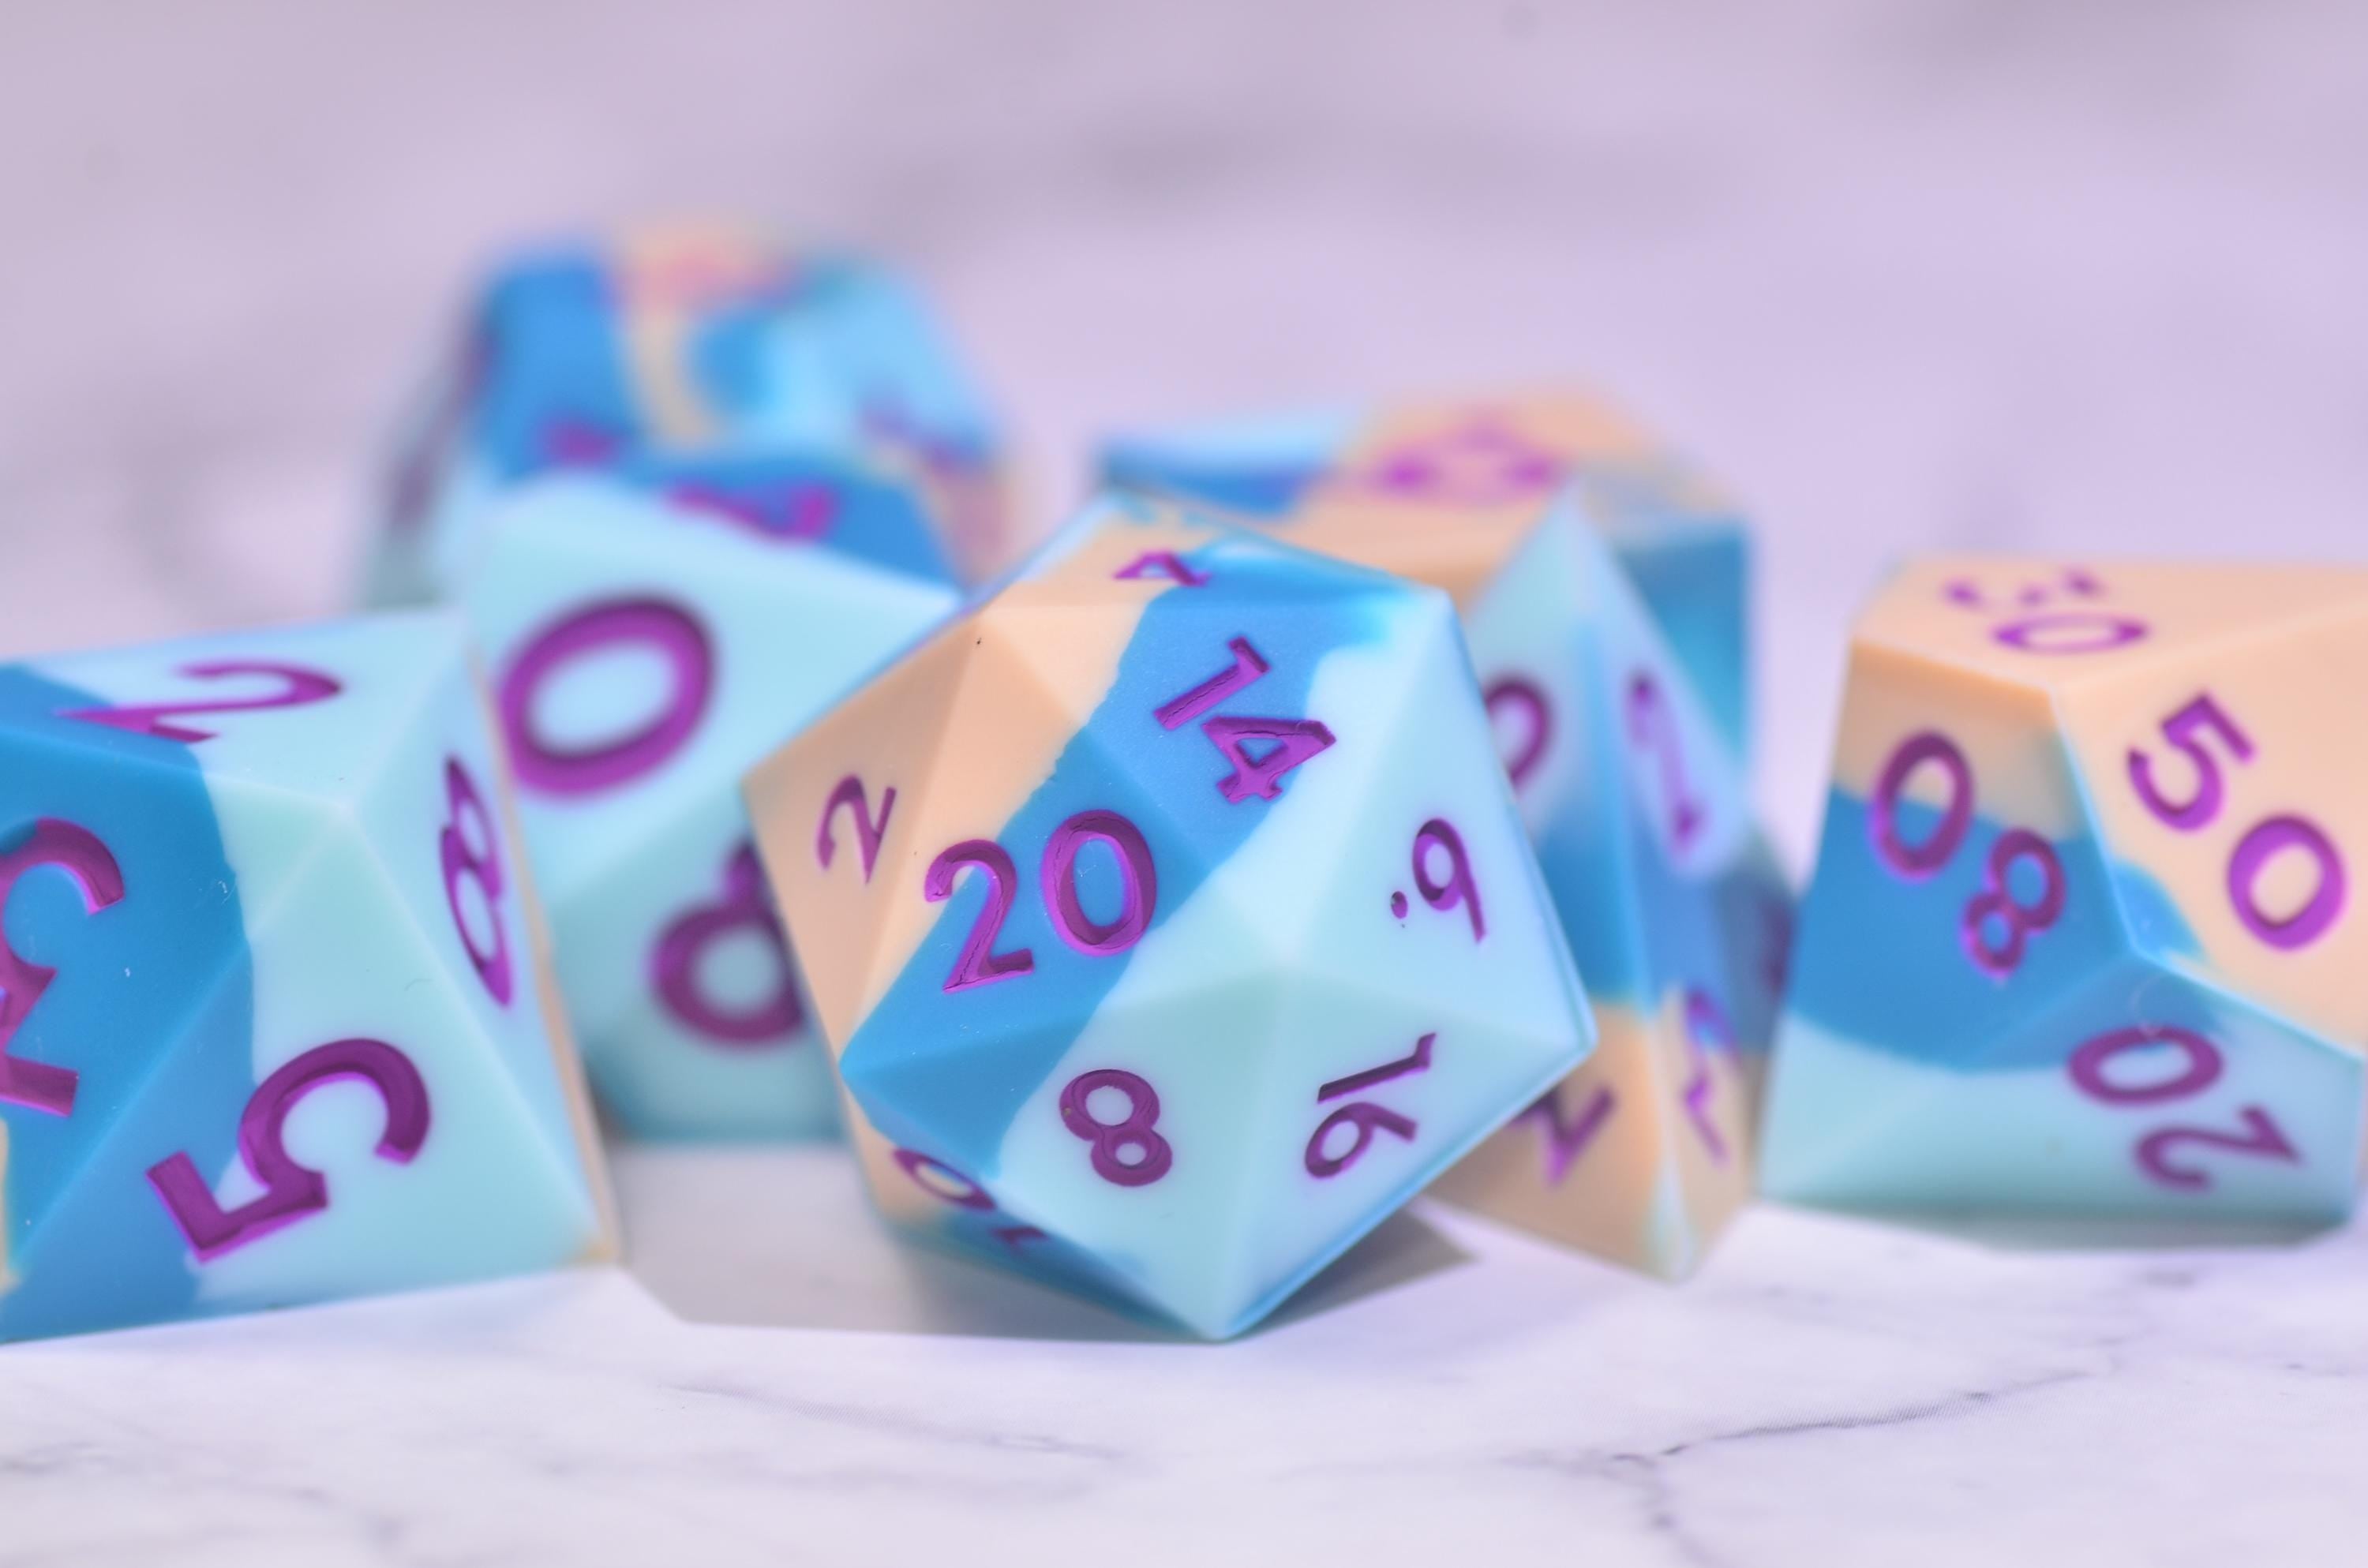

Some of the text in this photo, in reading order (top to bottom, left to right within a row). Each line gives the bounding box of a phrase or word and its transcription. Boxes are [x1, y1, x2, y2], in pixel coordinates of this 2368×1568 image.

[51, 660, 343, 743] 2
[496, 597, 717, 800] 0
[1151, 634, 1336, 805] 14
[440, 754, 515, 1008] 8
[815, 773, 897, 884] 2
[921, 808, 1159, 995] 20
[2125, 690, 2352, 955] 50
[145, 1036, 431, 1264] 5
[1057, 1068, 1174, 1187] 8
[1302, 1031, 1438, 1181] 16
[2066, 1023, 2306, 1194] 20
